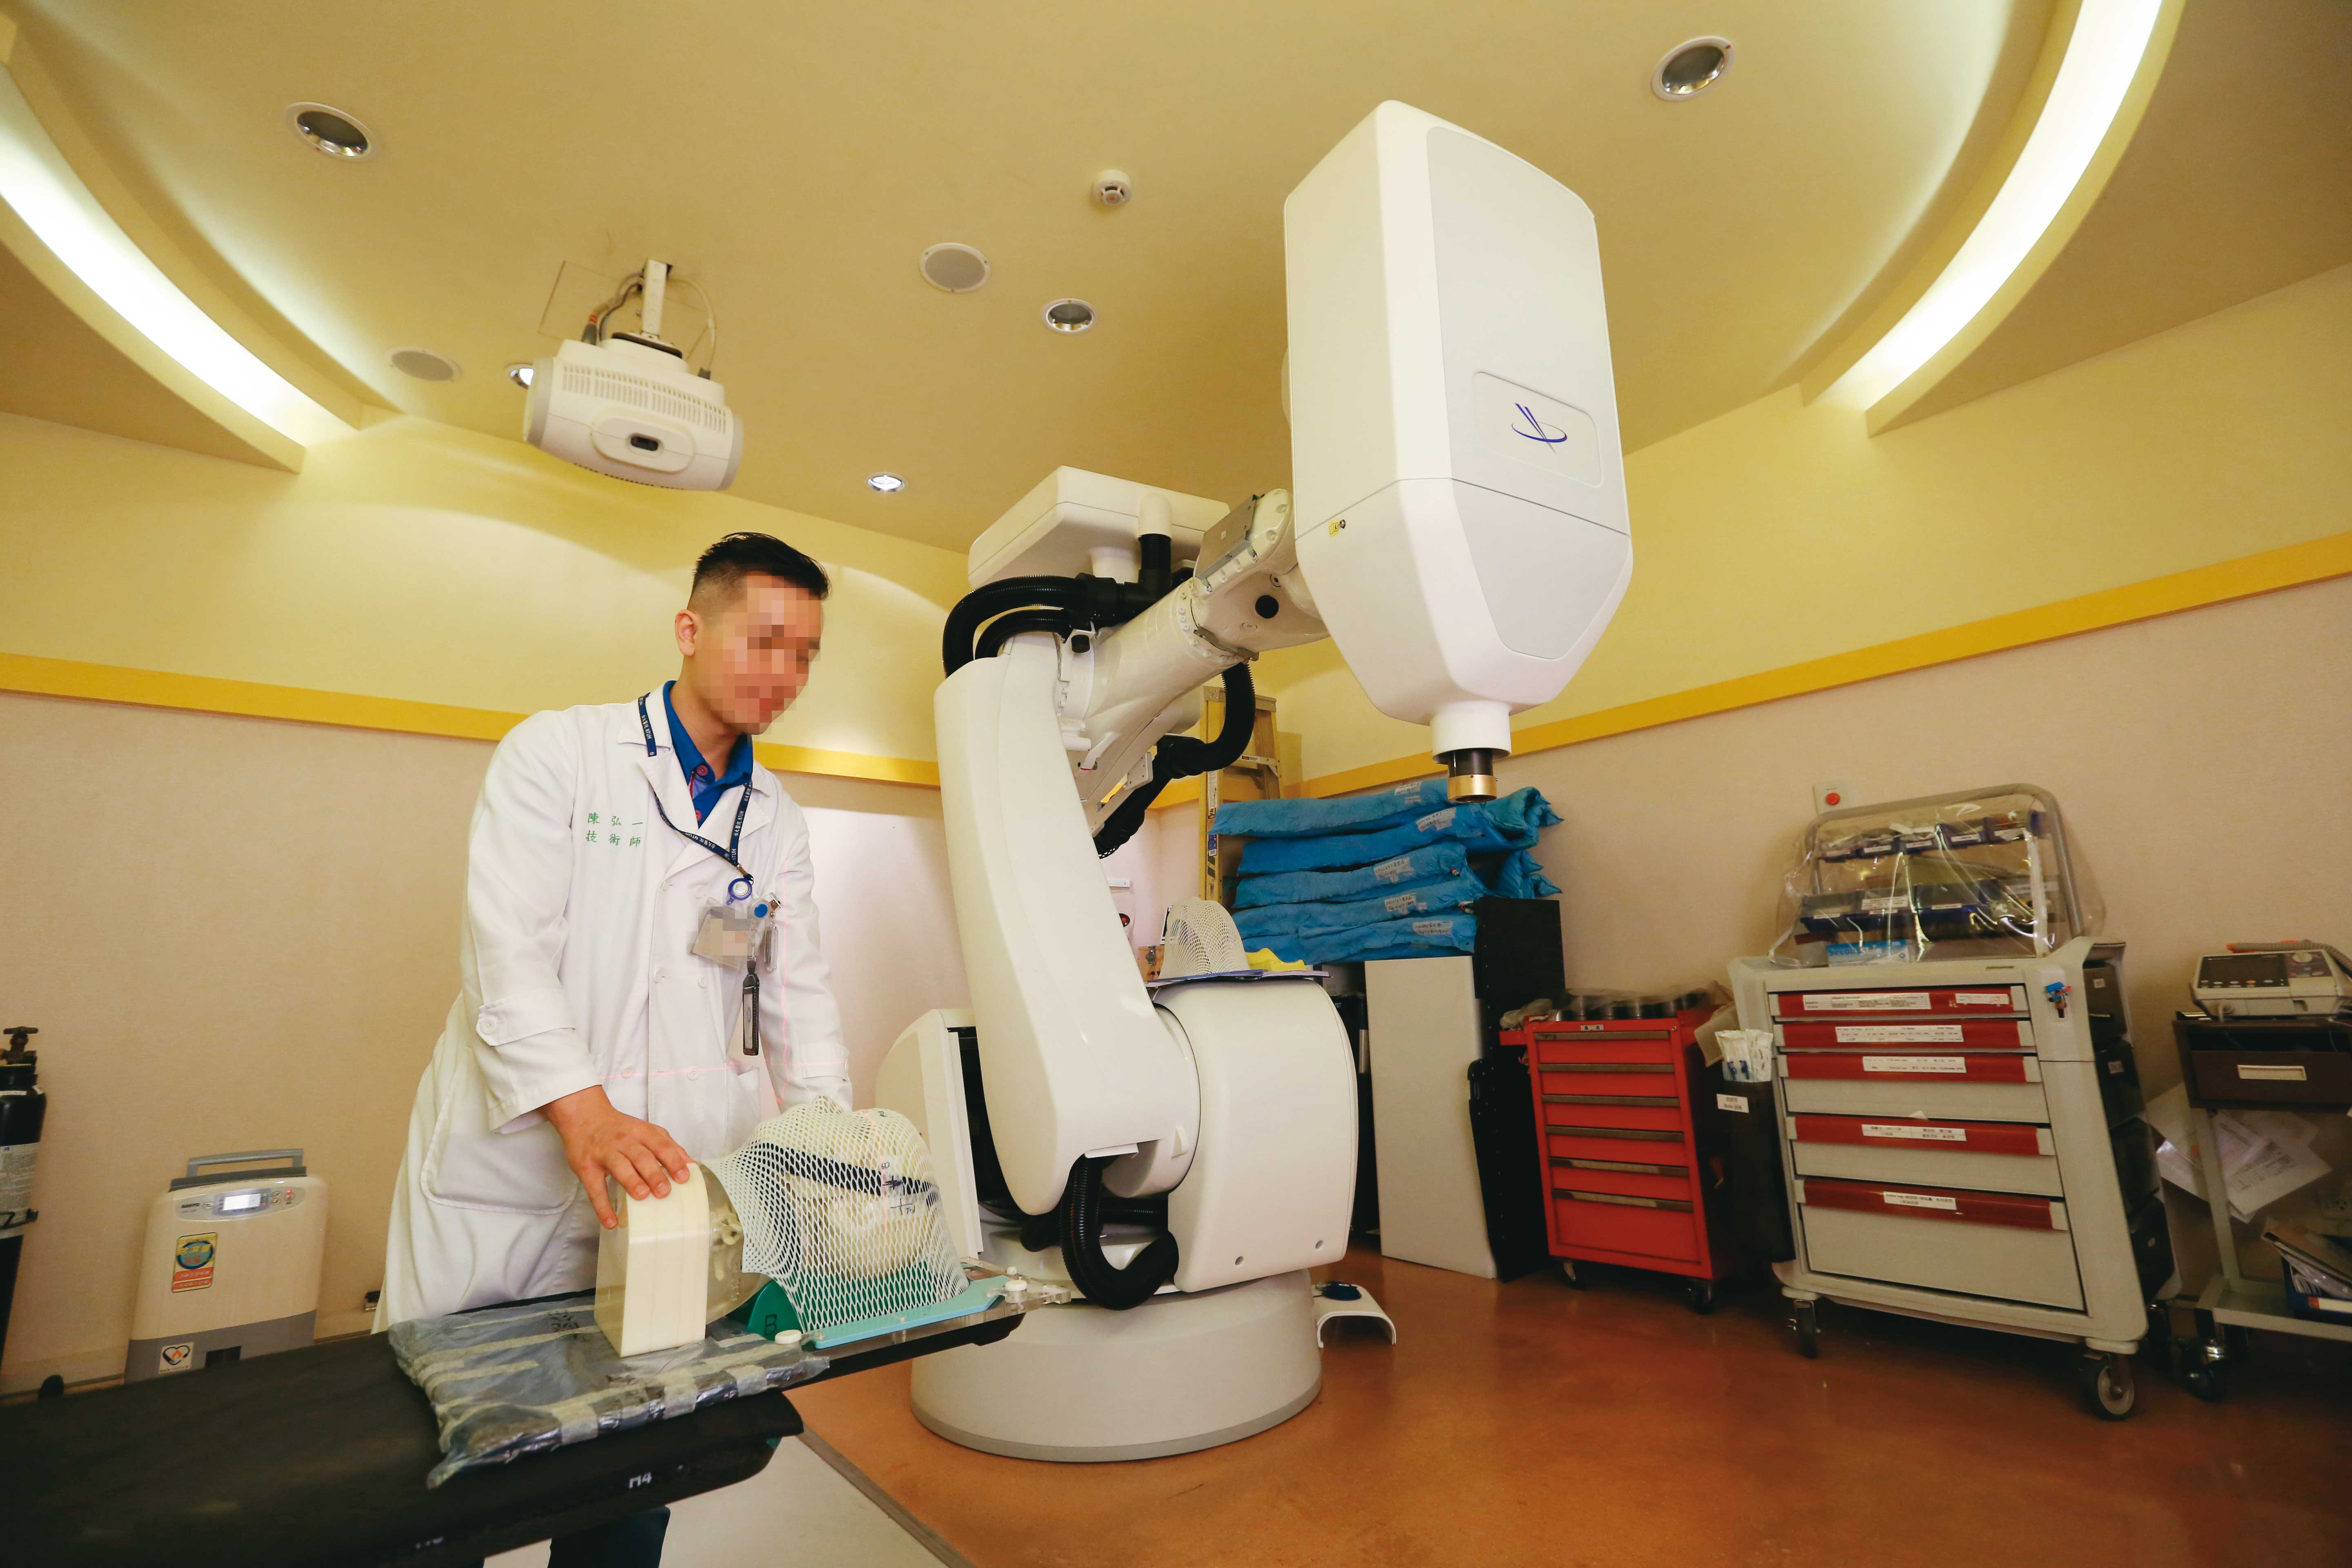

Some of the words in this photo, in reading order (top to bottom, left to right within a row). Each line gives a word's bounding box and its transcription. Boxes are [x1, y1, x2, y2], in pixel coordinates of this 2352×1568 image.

[588, 812, 643, 826] 陳弘一
[586, 830, 641, 848] 技術師
[685, 832, 699, 840] NTUH
[699, 837, 715, 849] 台大醫院
[764, 1314, 777, 1336] B
